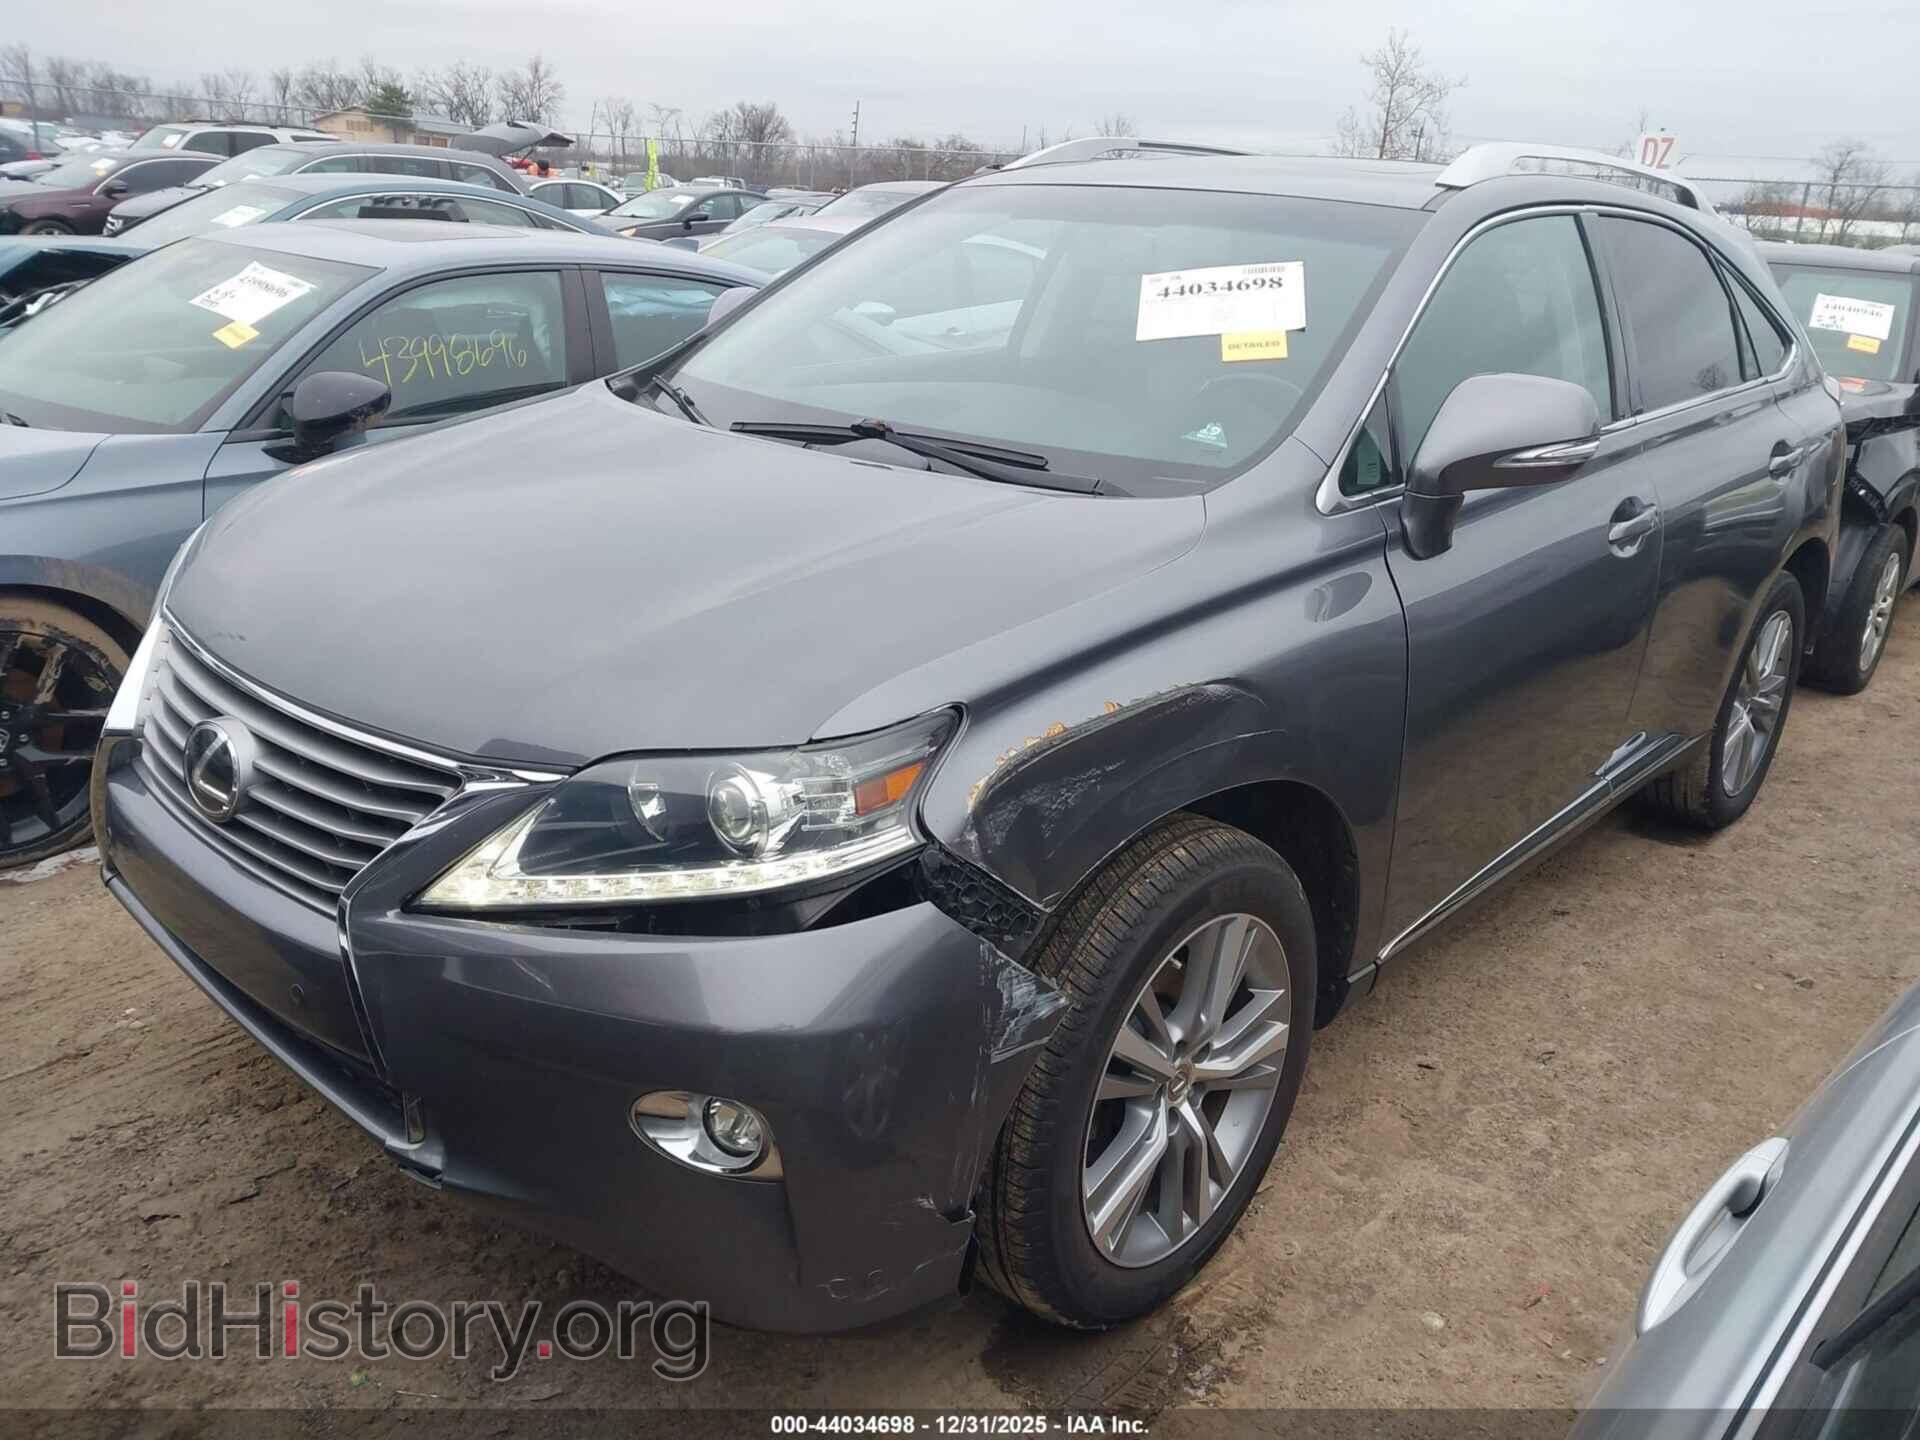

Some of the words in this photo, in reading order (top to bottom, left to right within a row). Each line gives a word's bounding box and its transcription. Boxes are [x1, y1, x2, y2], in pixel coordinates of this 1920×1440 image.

[1156, 276, 1283, 299] 44034698
[1227, 340, 1281, 351] DETAILED
[358, 328, 527, 387] 43998696
